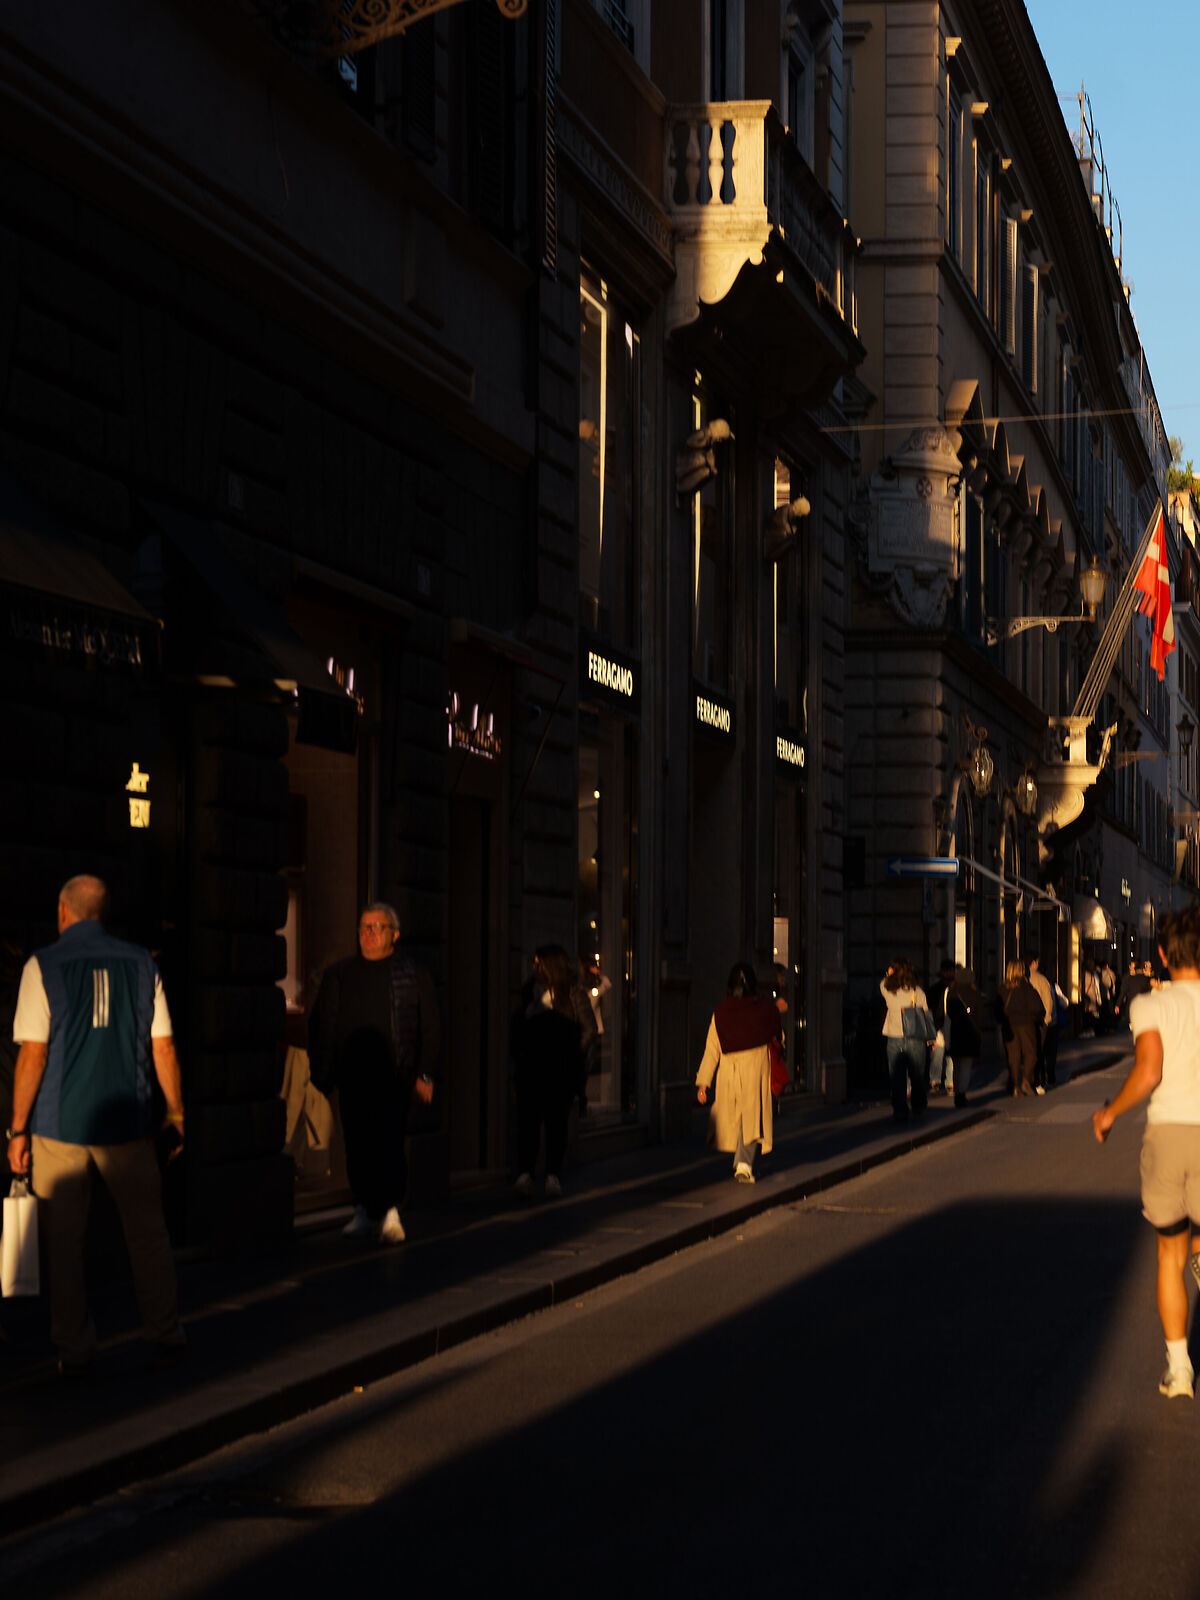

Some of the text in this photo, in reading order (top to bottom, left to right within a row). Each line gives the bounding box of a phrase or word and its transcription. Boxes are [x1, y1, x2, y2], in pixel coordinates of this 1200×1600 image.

[588, 650, 634, 697] FERRAGAMO
[696, 695, 731, 734] FERRAGAMO
[776, 735, 805, 768] FERRAGAMO
